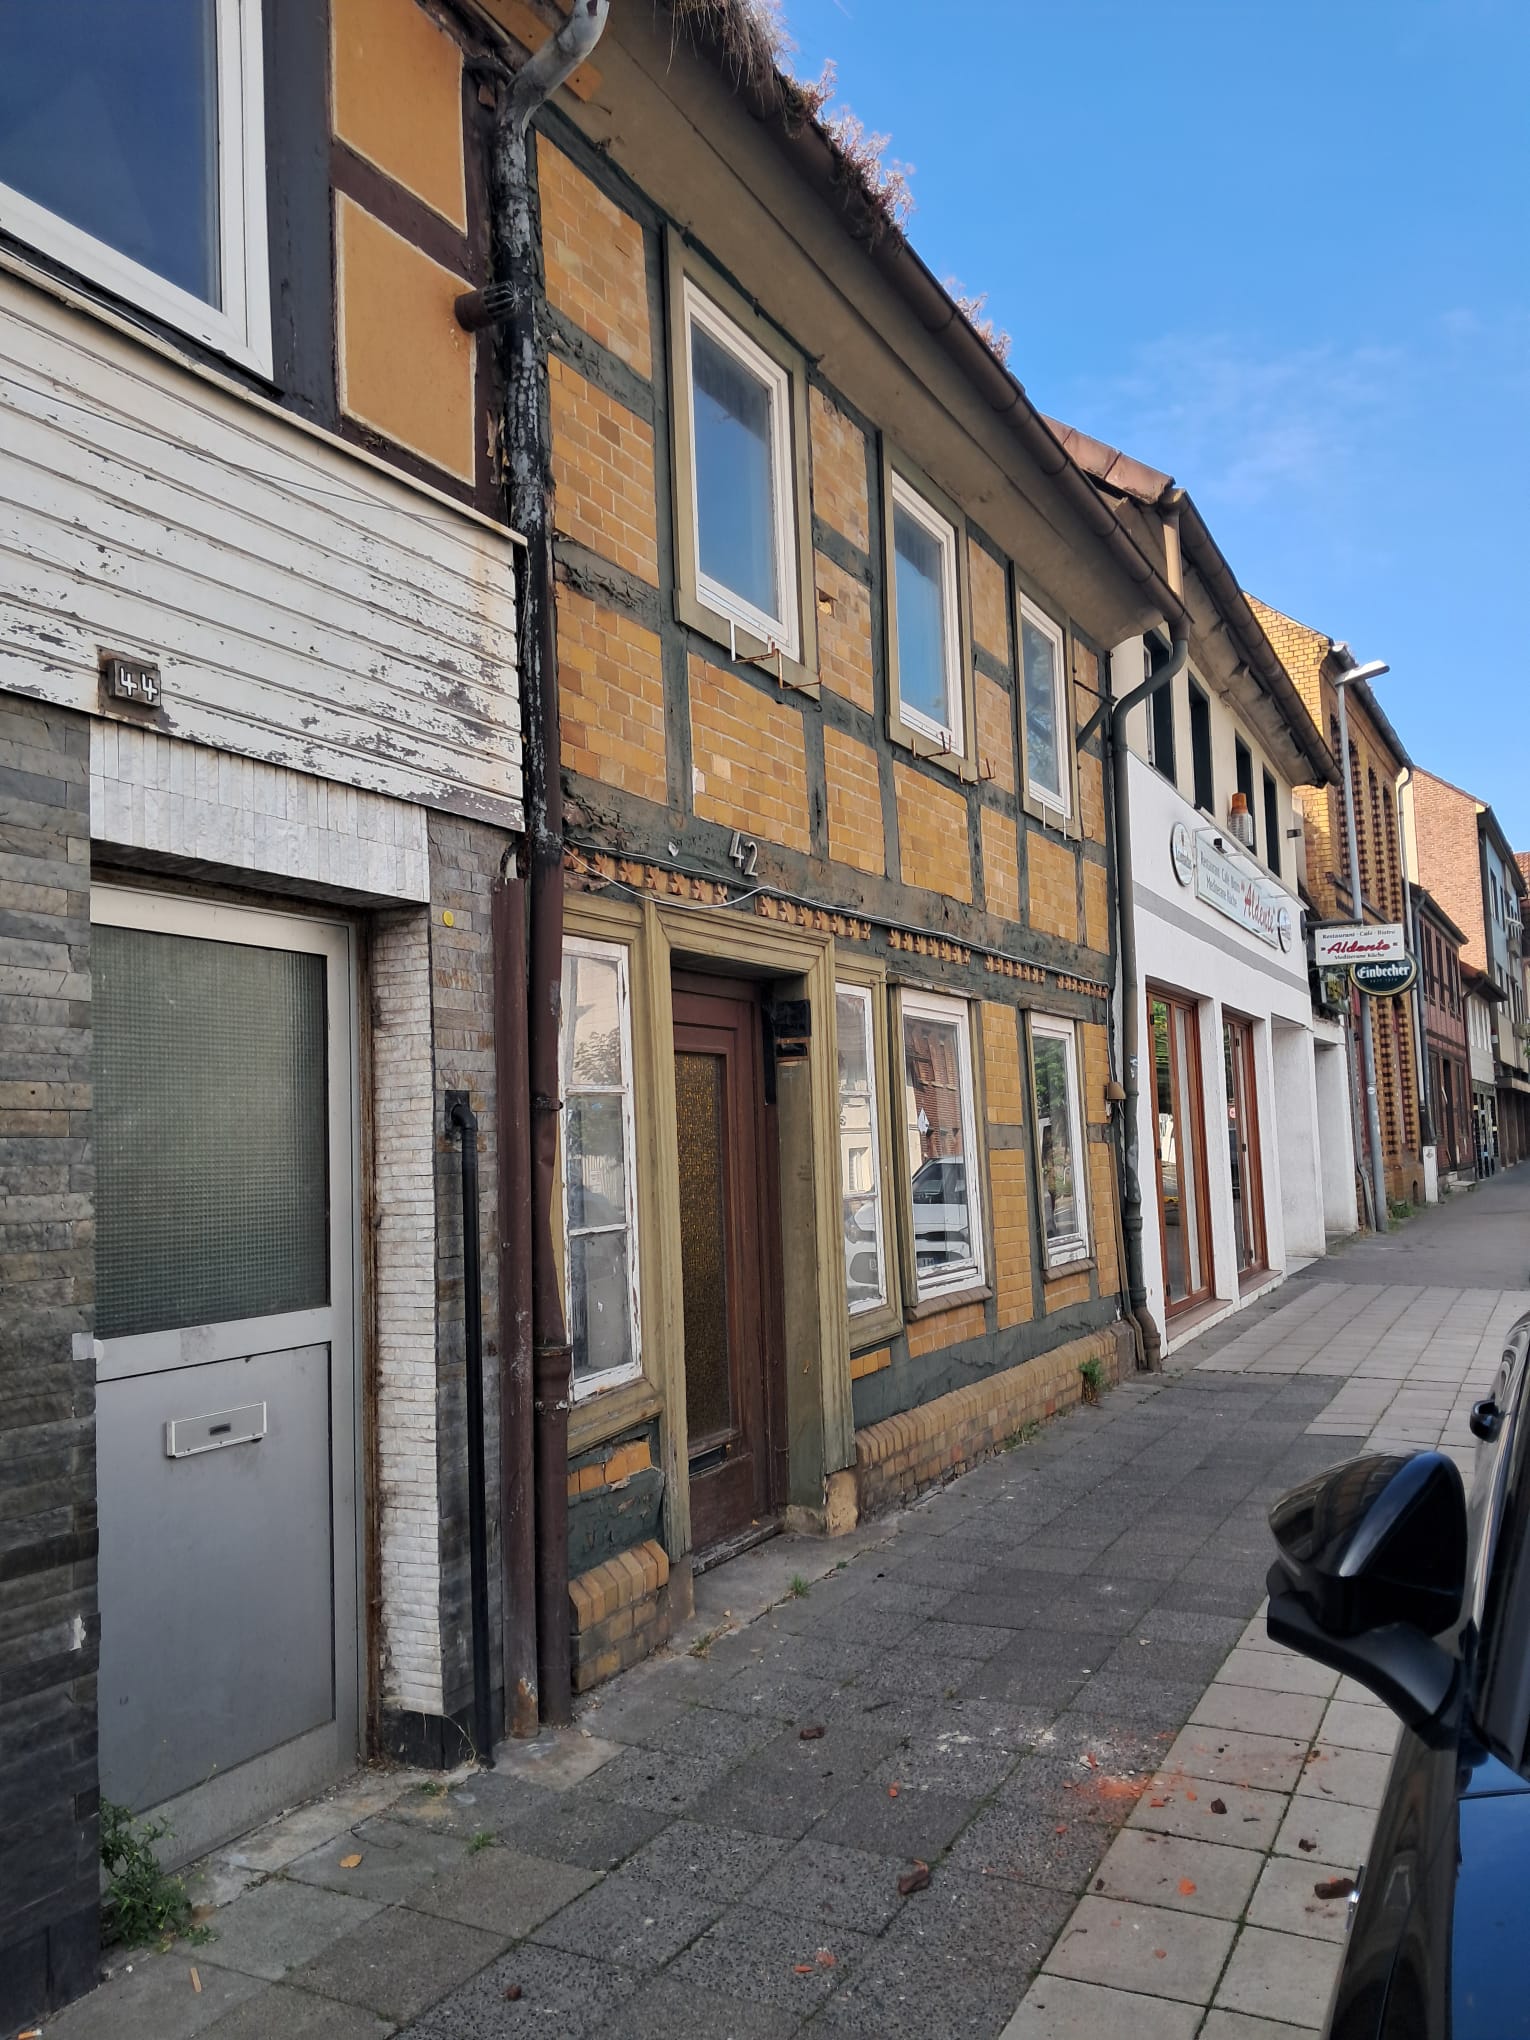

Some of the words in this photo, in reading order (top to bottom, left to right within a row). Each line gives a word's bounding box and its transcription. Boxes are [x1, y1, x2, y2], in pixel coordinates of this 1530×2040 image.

[119, 666, 159, 702] 44
[729, 831, 759, 877] 42
[1327, 939, 1391, 954] Aldente
